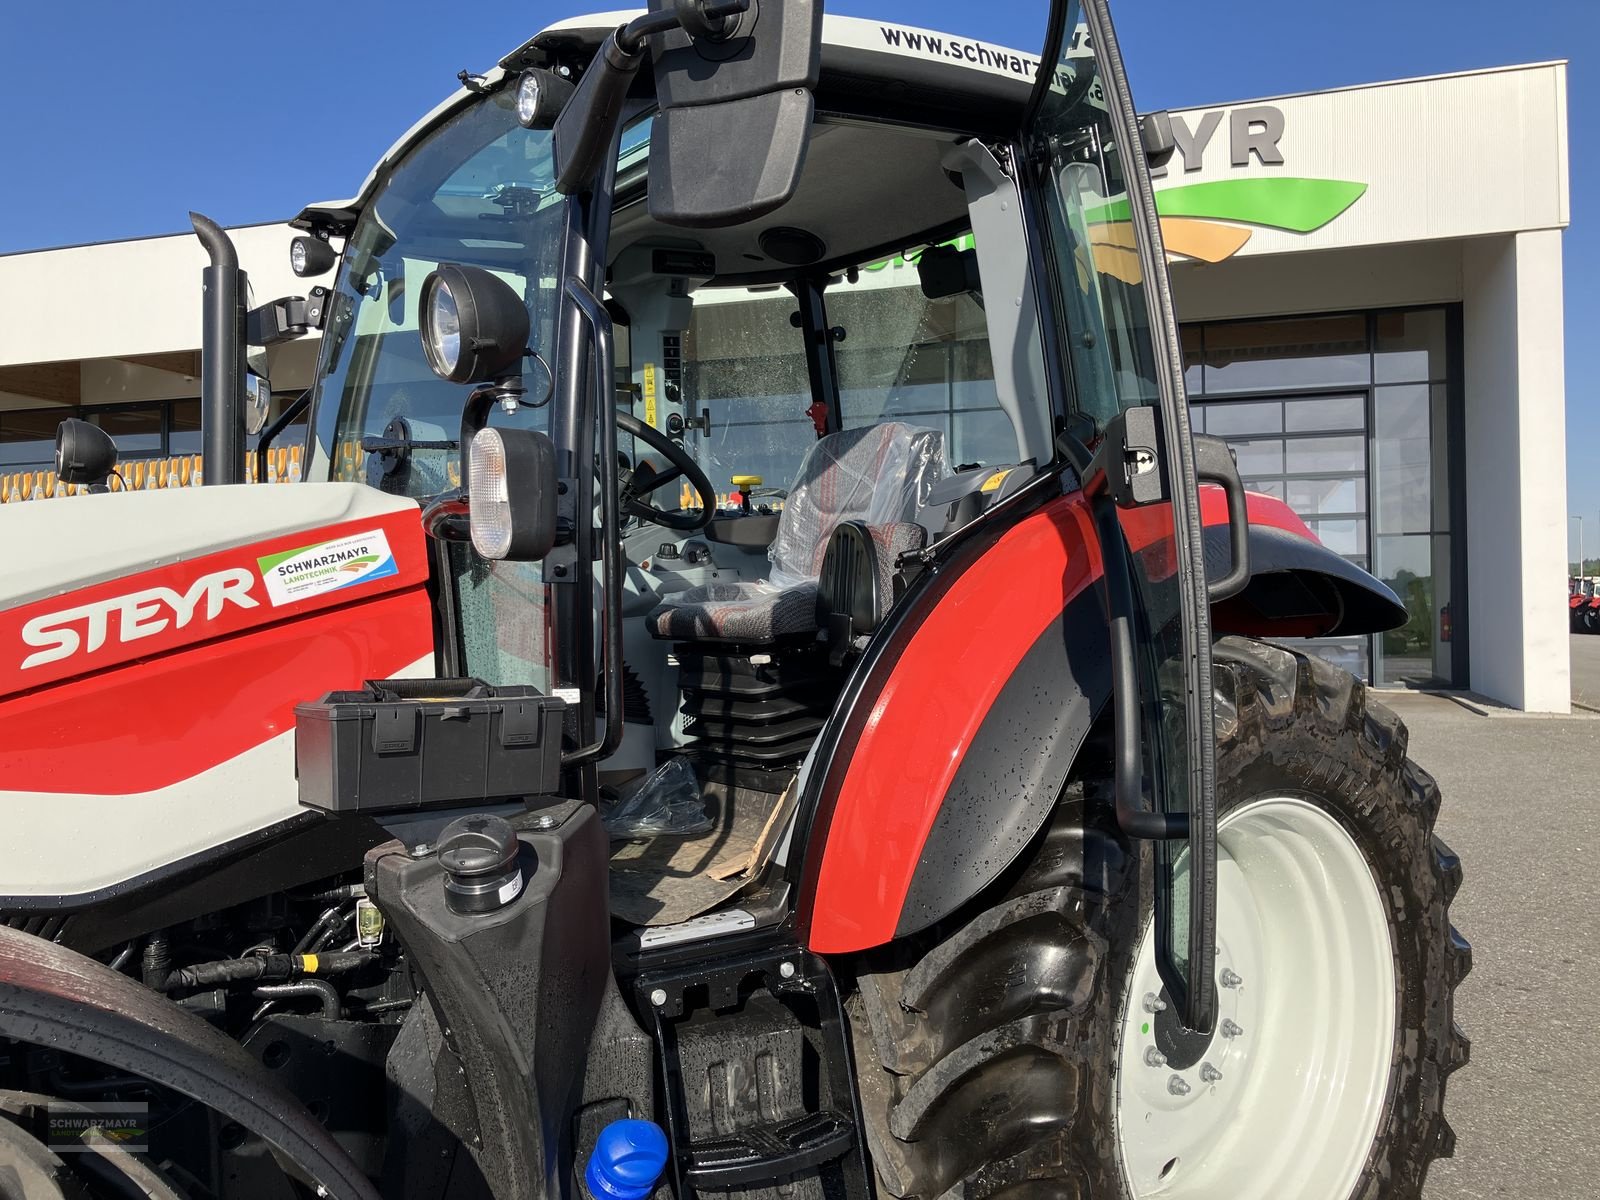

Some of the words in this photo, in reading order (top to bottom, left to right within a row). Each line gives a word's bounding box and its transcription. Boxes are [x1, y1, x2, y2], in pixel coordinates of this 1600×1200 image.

[278, 546, 369, 576] SCHWARZMAYR
[283, 566, 338, 585] LANDTECHNIK
[20, 567, 261, 670] STEYR
